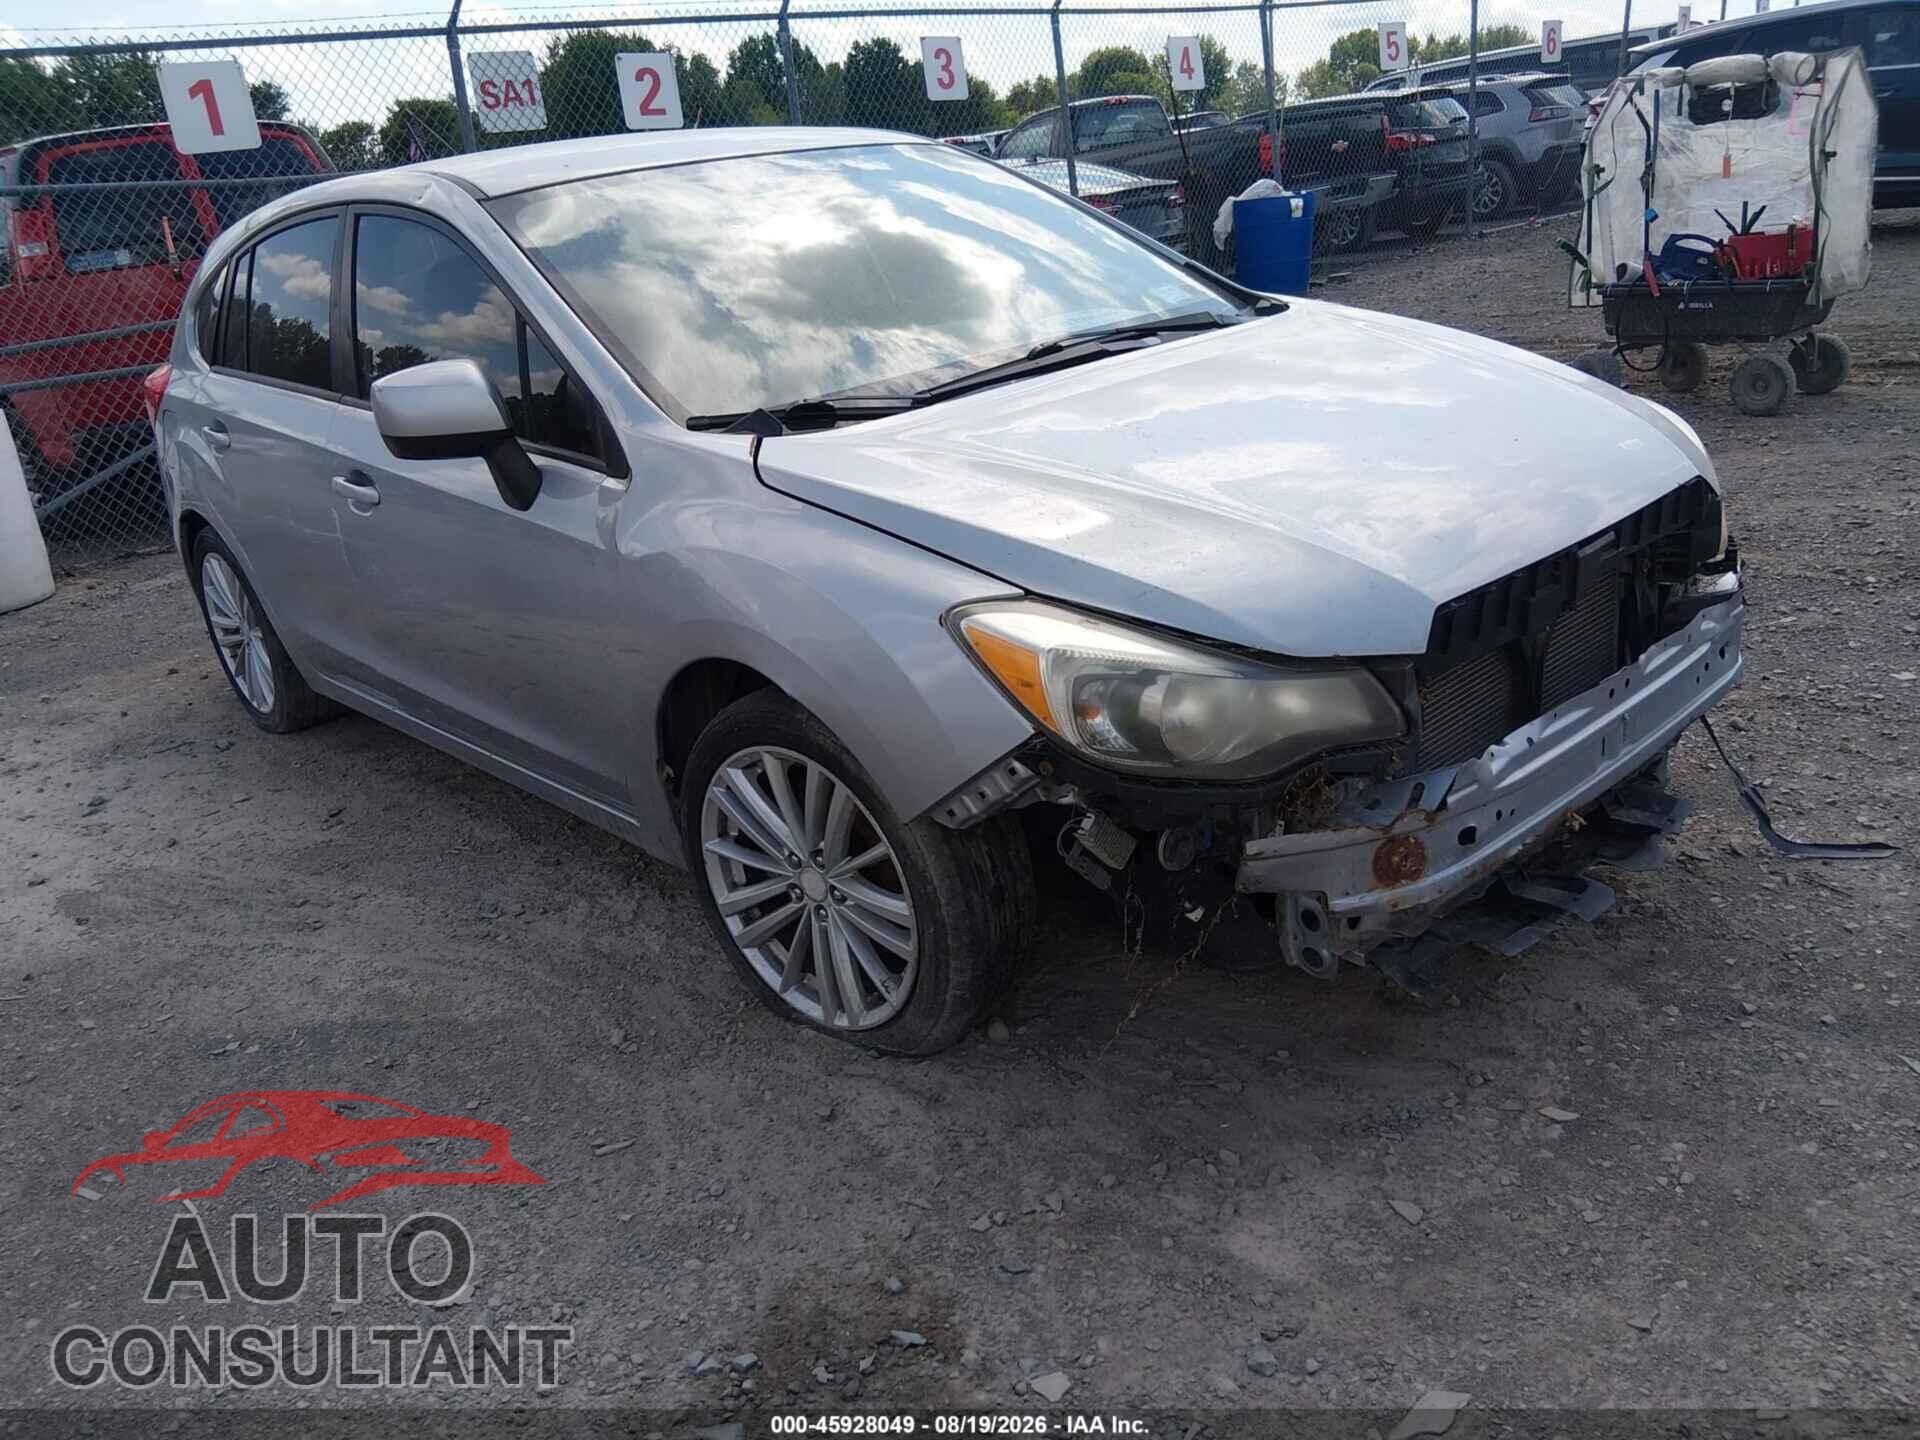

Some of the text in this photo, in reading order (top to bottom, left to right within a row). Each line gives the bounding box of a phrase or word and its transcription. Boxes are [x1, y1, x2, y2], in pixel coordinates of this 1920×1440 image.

[1386, 31, 1399, 62] 5
[1546, 28, 1556, 55] 6
[933, 47, 955, 90] 3
[1179, 46, 1195, 80] 4
[187, 79, 224, 136] 1
[479, 78, 537, 110] SA1
[634, 67, 667, 116] 2
